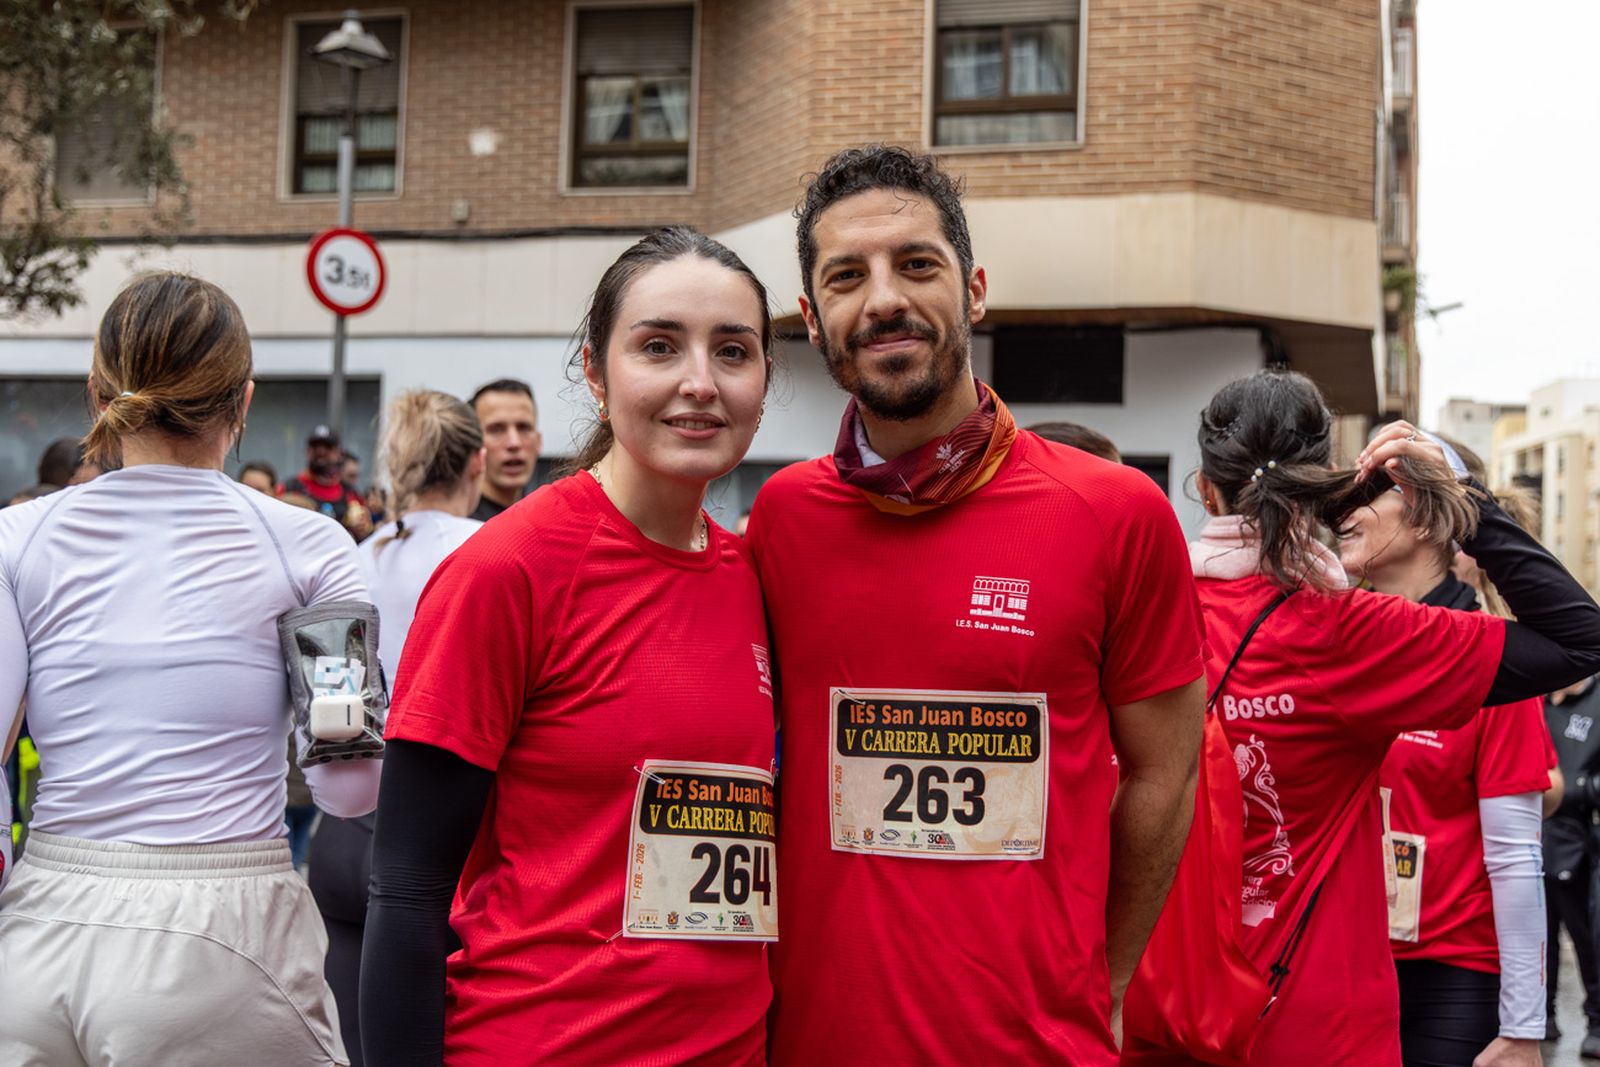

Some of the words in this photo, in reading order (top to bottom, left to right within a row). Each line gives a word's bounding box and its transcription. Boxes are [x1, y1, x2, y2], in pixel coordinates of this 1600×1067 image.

[974, 621, 989, 630] San
[990, 623, 1010, 632] Juan
[1011, 625, 1035, 637] Bosco
[850, 704, 876, 724] IES
[881, 705, 914, 725] San
[919, 706, 963, 727] Juan
[971, 706, 1027, 727] Bosco
[845, 728, 856, 750] V
[861, 728, 941, 754] CARRERA
[948, 732, 1032, 757] POPULAR
[656, 779, 683, 799] IES
[688, 780, 722, 802] San
[726, 782, 760, 804] Juan
[883, 764, 986, 826] 263
[649, 804, 662, 828] V
[667, 804, 745, 832] CARRERA
[636, 843, 645, 864] 2026
[689, 842, 771, 906] 264
